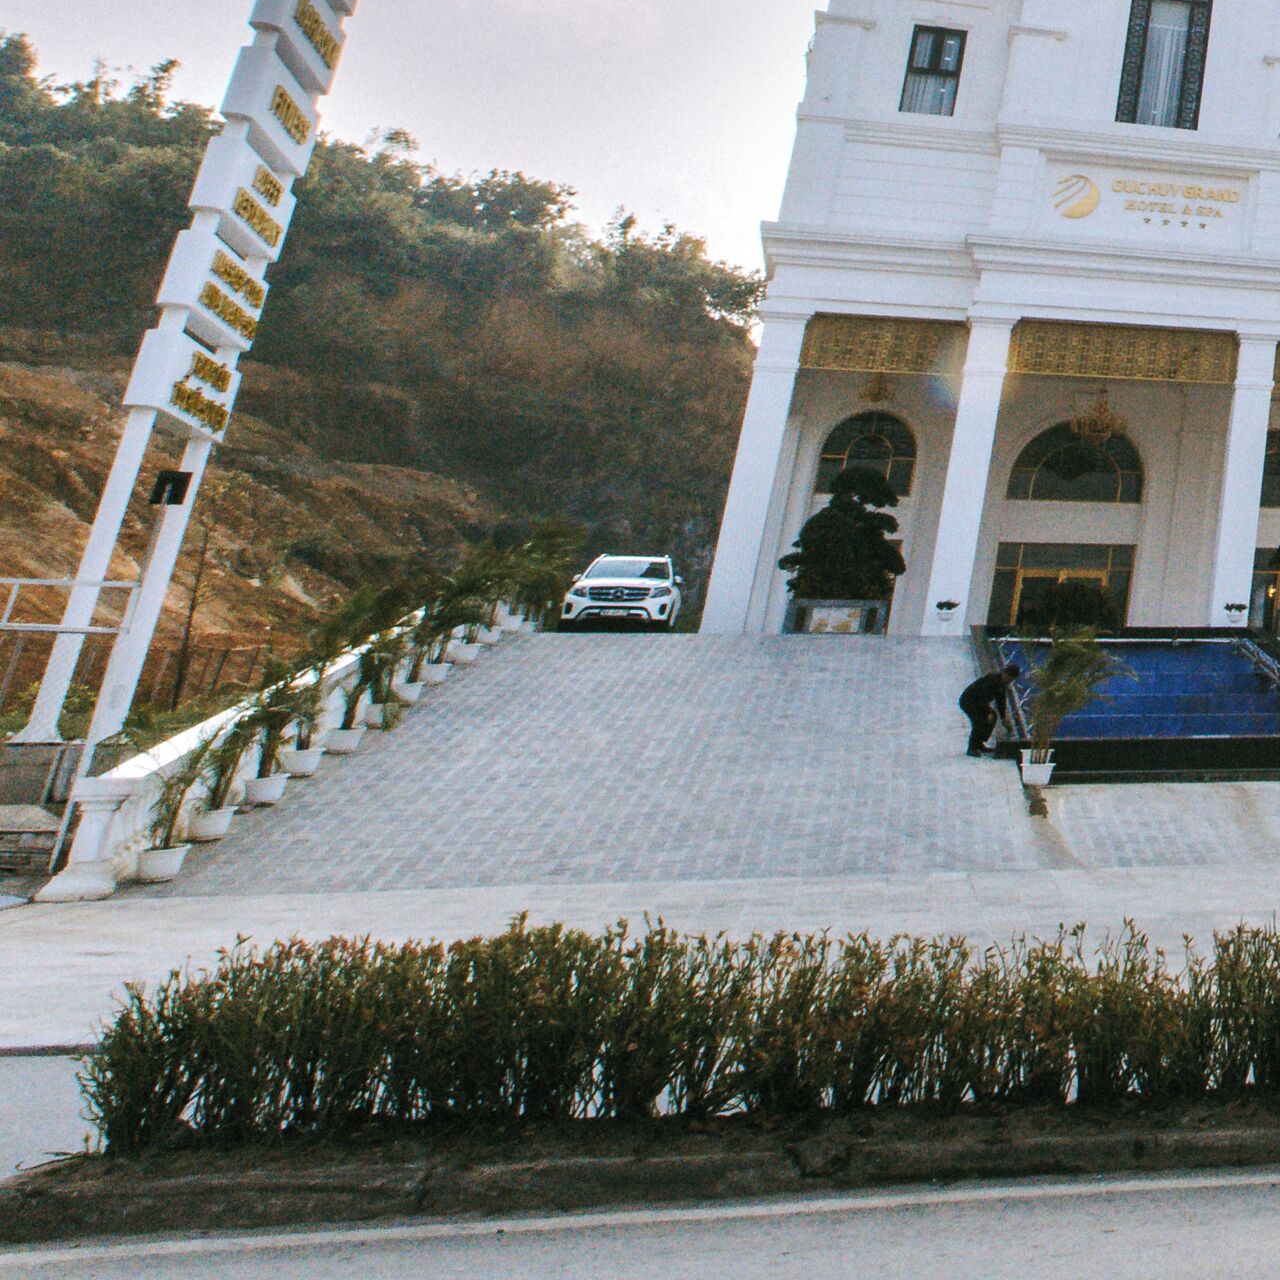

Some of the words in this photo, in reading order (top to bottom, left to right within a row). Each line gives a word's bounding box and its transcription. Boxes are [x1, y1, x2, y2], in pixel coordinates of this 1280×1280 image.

[1183, 184, 1240, 204] GRAND
[1124, 200, 1177, 215] HOTEL
[1196, 205, 1224, 218] SPA
